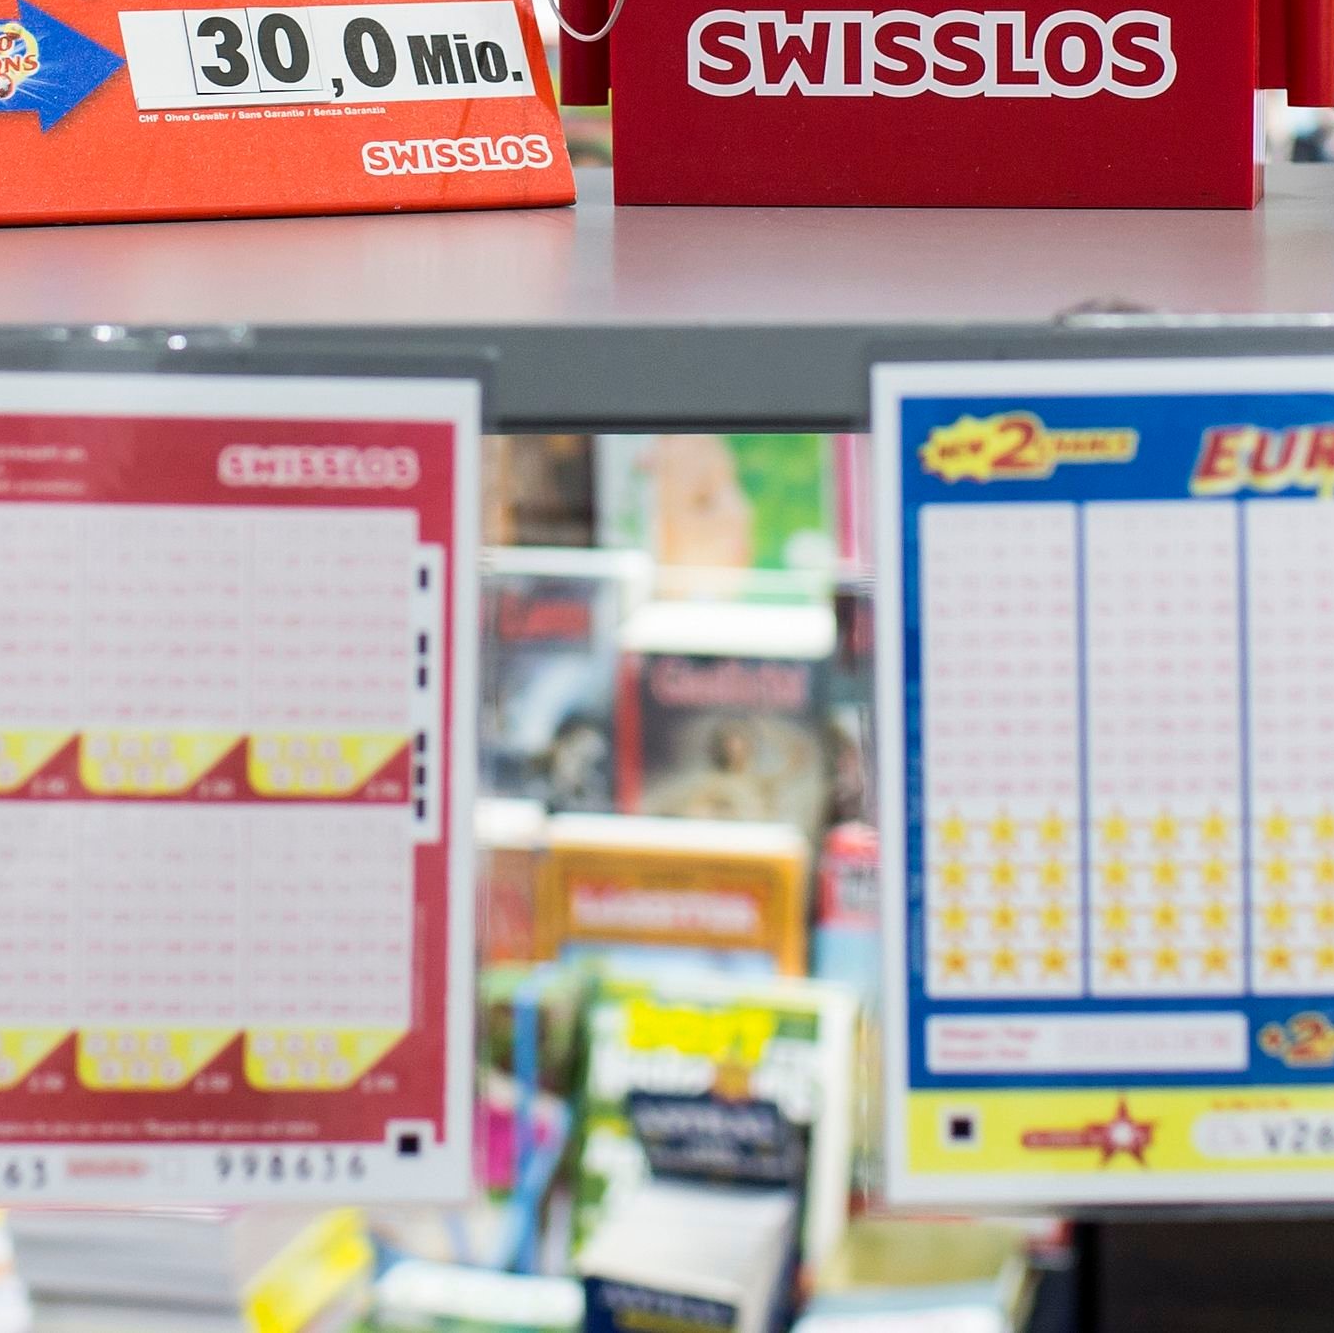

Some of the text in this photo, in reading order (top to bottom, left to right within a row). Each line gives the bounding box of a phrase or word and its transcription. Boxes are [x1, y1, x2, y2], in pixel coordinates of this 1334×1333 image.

[407, 33, 524, 86] Mio.
[691, 13, 1173, 95] SWISSLOS
[138, 114, 159, 124] CHF
[164, 113, 191, 122] Ohne
[192, 111, 229, 121] Gewähr
[238, 110, 262, 120] Sans
[263, 109, 305, 119] Garantie
[313, 107, 343, 117] Senza
[344, 106, 386, 116] Garanzia
[363, 135, 552, 175] SWISSLOS
[217, 445, 419, 489] SWISSLOS
[991, 419, 1036, 470] 2
